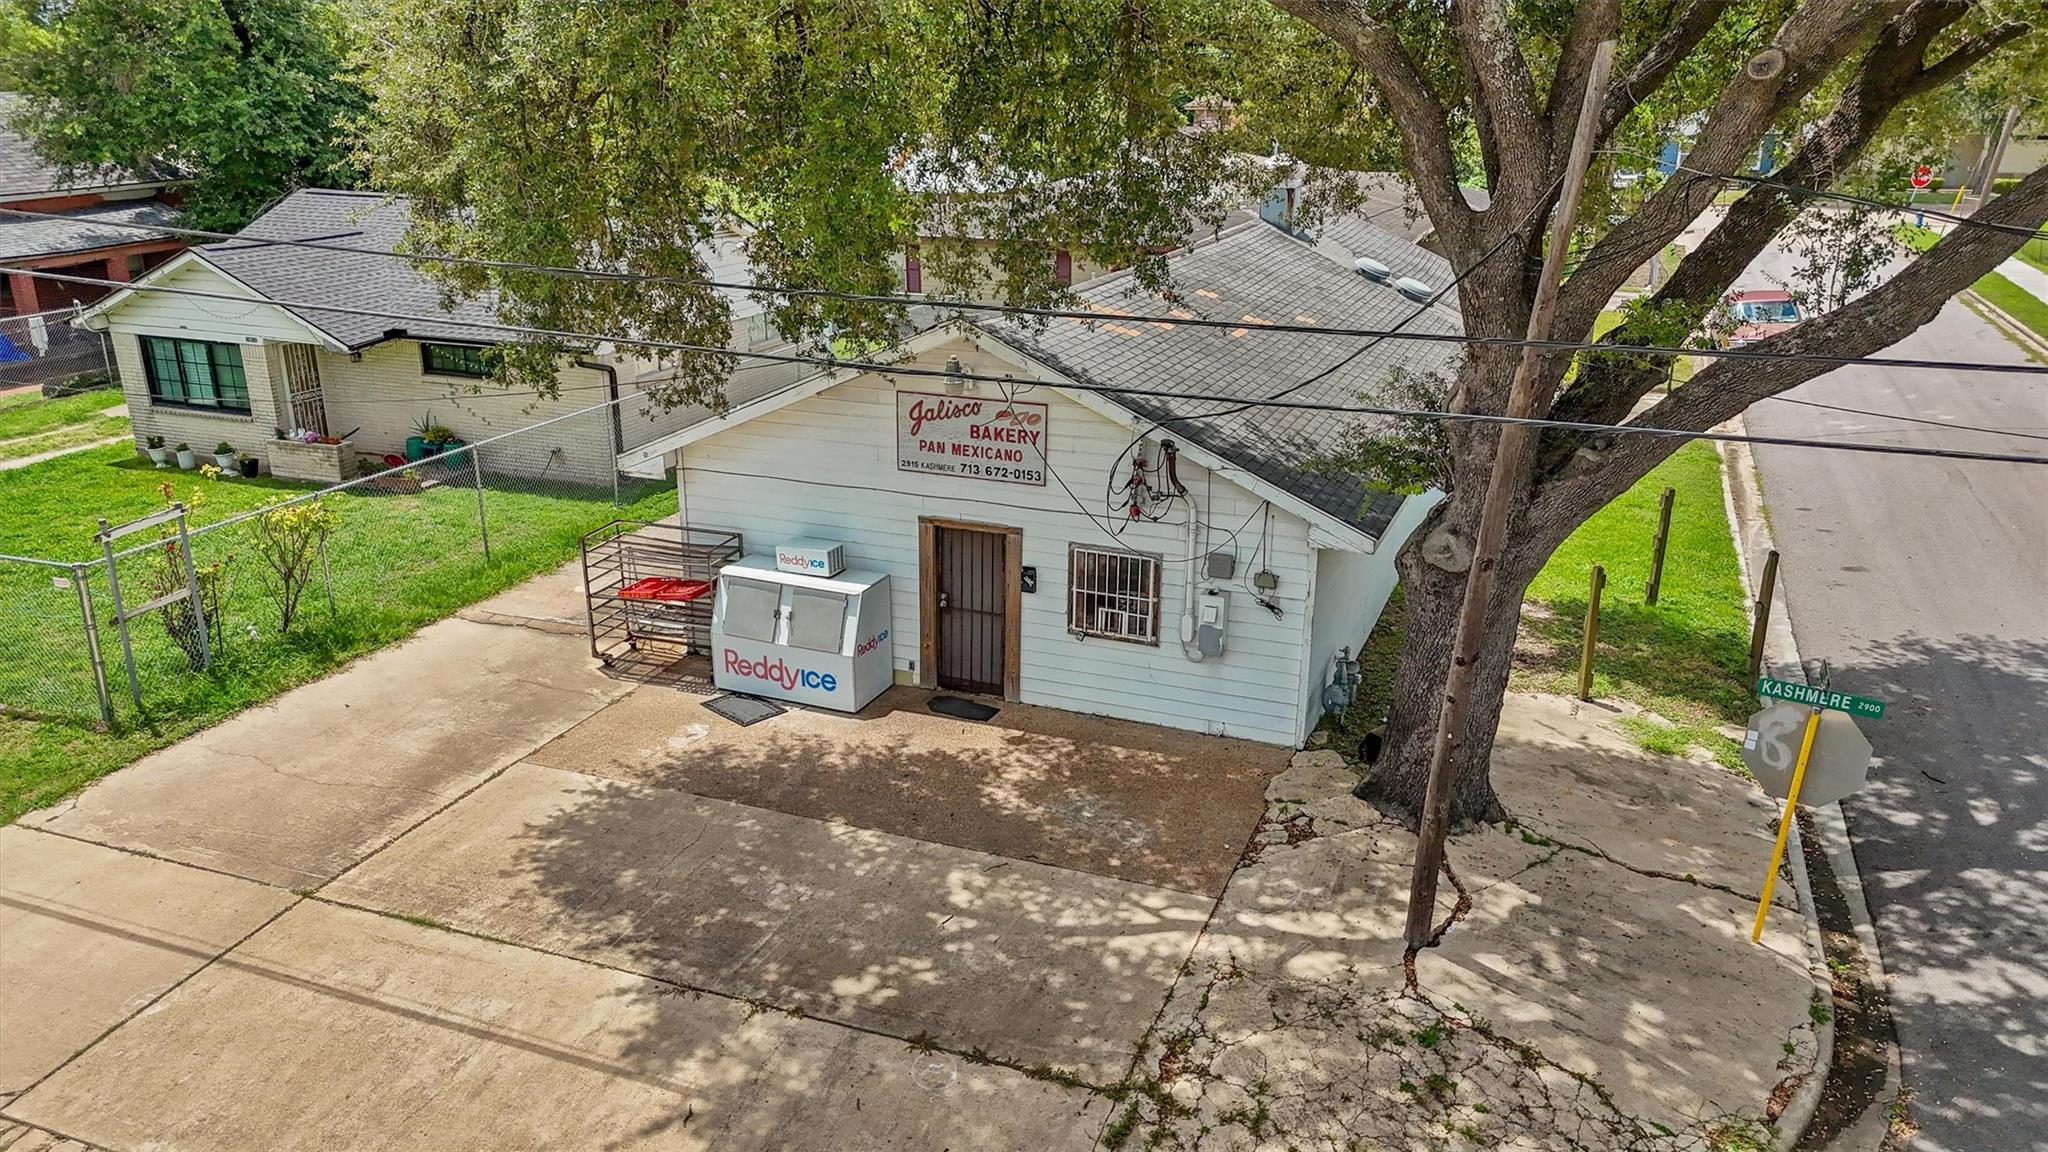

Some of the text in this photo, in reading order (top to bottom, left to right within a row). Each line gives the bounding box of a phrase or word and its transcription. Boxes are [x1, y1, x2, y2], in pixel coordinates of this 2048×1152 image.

[909, 399, 982, 436] Jalisco
[970, 424, 1041, 446] BAKERY
[919, 439, 1023, 463] PAN MEXICANO
[901, 460, 1042, 482] 2915 KASHMERE 713 672-0153
[1761, 680, 1881, 713] KASHMERE 2900
